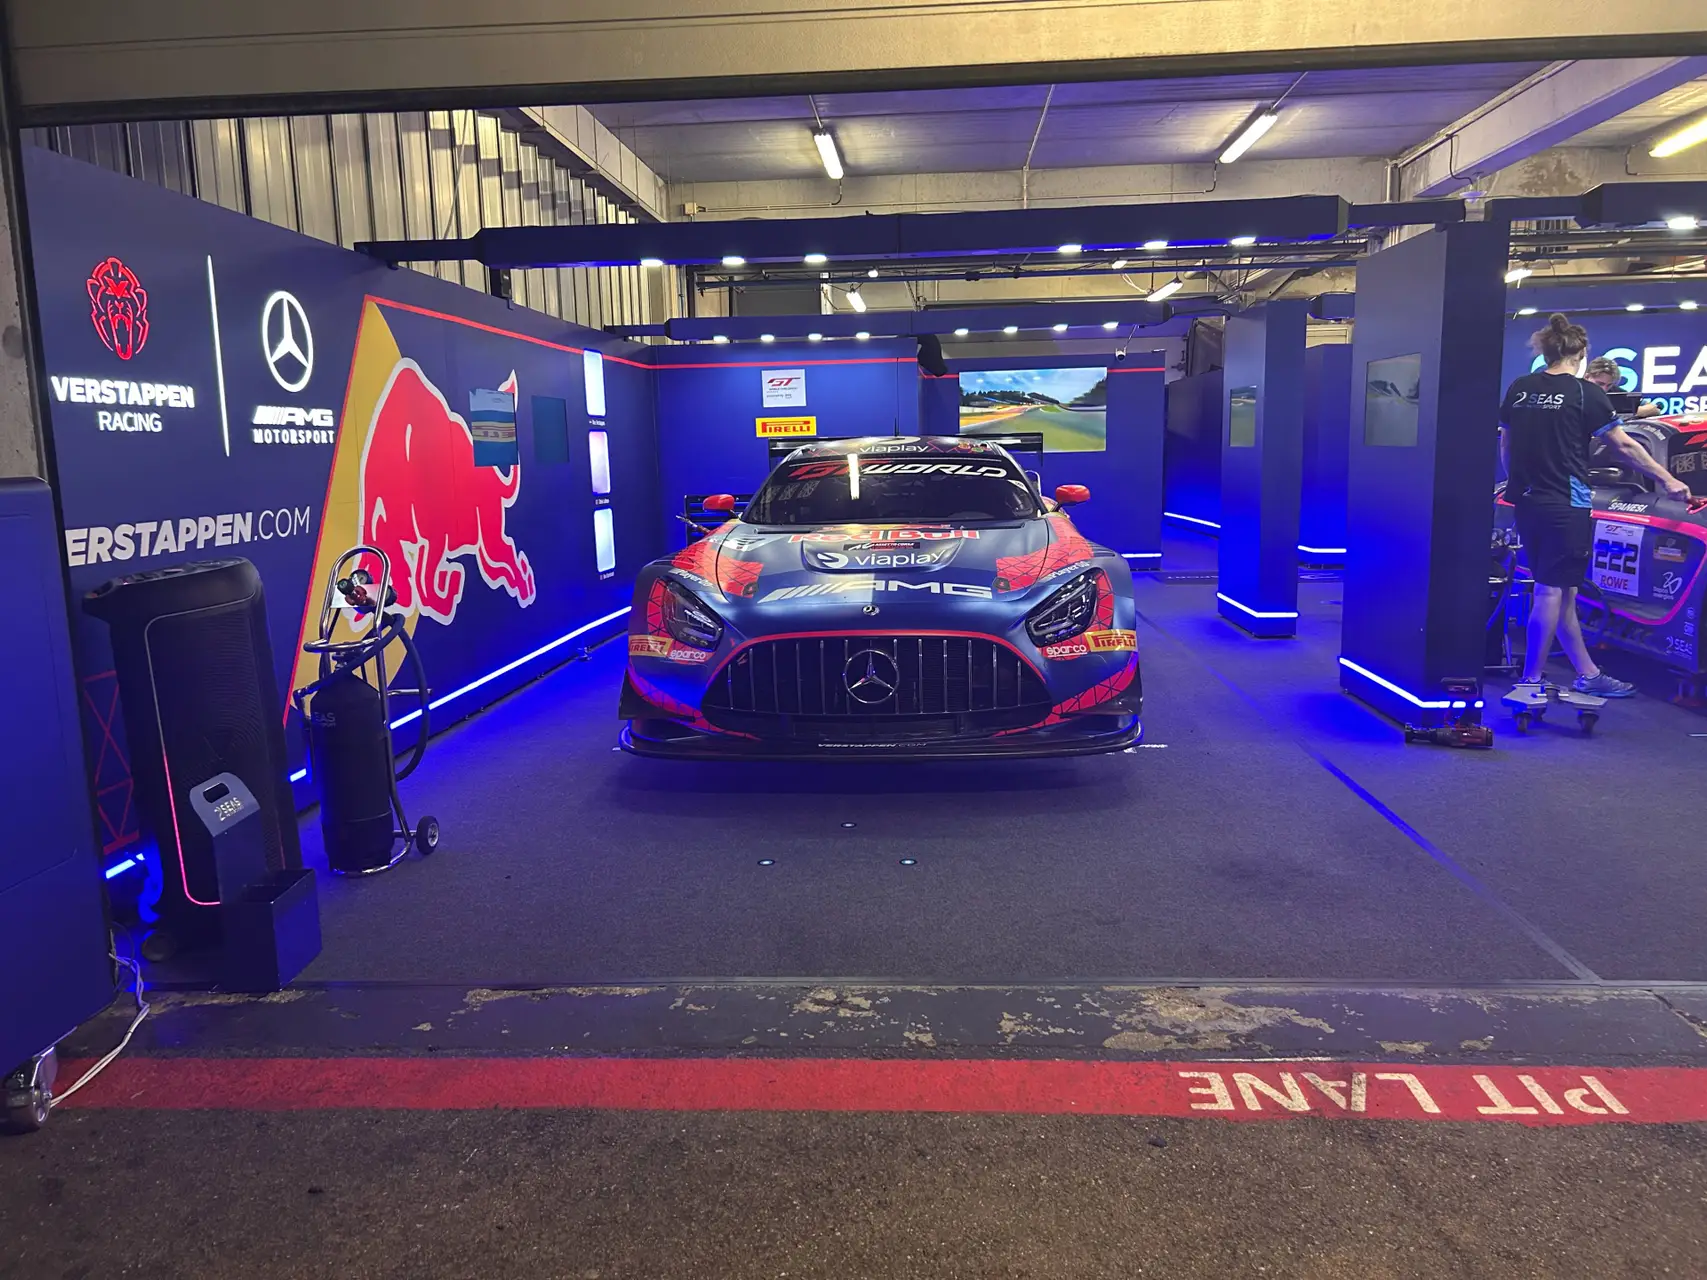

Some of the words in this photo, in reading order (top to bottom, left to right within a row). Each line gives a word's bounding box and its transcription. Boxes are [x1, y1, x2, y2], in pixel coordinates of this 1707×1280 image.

[1596, 345, 1707, 394] SEA
[51, 376, 195, 408] VERSTAPPEN
[1512, 391, 1527, 408] 2
[1529, 393, 1565, 405] SEAS
[98, 411, 162, 432] RACING
[274, 406, 334, 427] AMG
[761, 420, 811, 433] PIRELLI
[252, 428, 334, 444] MOTORSPORT
[860, 443, 928, 453] viaplay
[65, 505, 311, 567] ERSTAPPEN.COM
[787, 529, 882, 543] Red
[883, 529, 980, 540] Bull
[854, 549, 948, 568] viaplay
[1594, 538, 1638, 575] 222
[830, 579, 992, 600] AMG
[1600, 575, 1628, 590] ROWE
[670, 649, 706, 660] sparco
[1046, 644, 1087, 656] sparco
[1179, 1071, 1442, 1113] LANE
[1472, 1074, 1630, 1114] PIT
